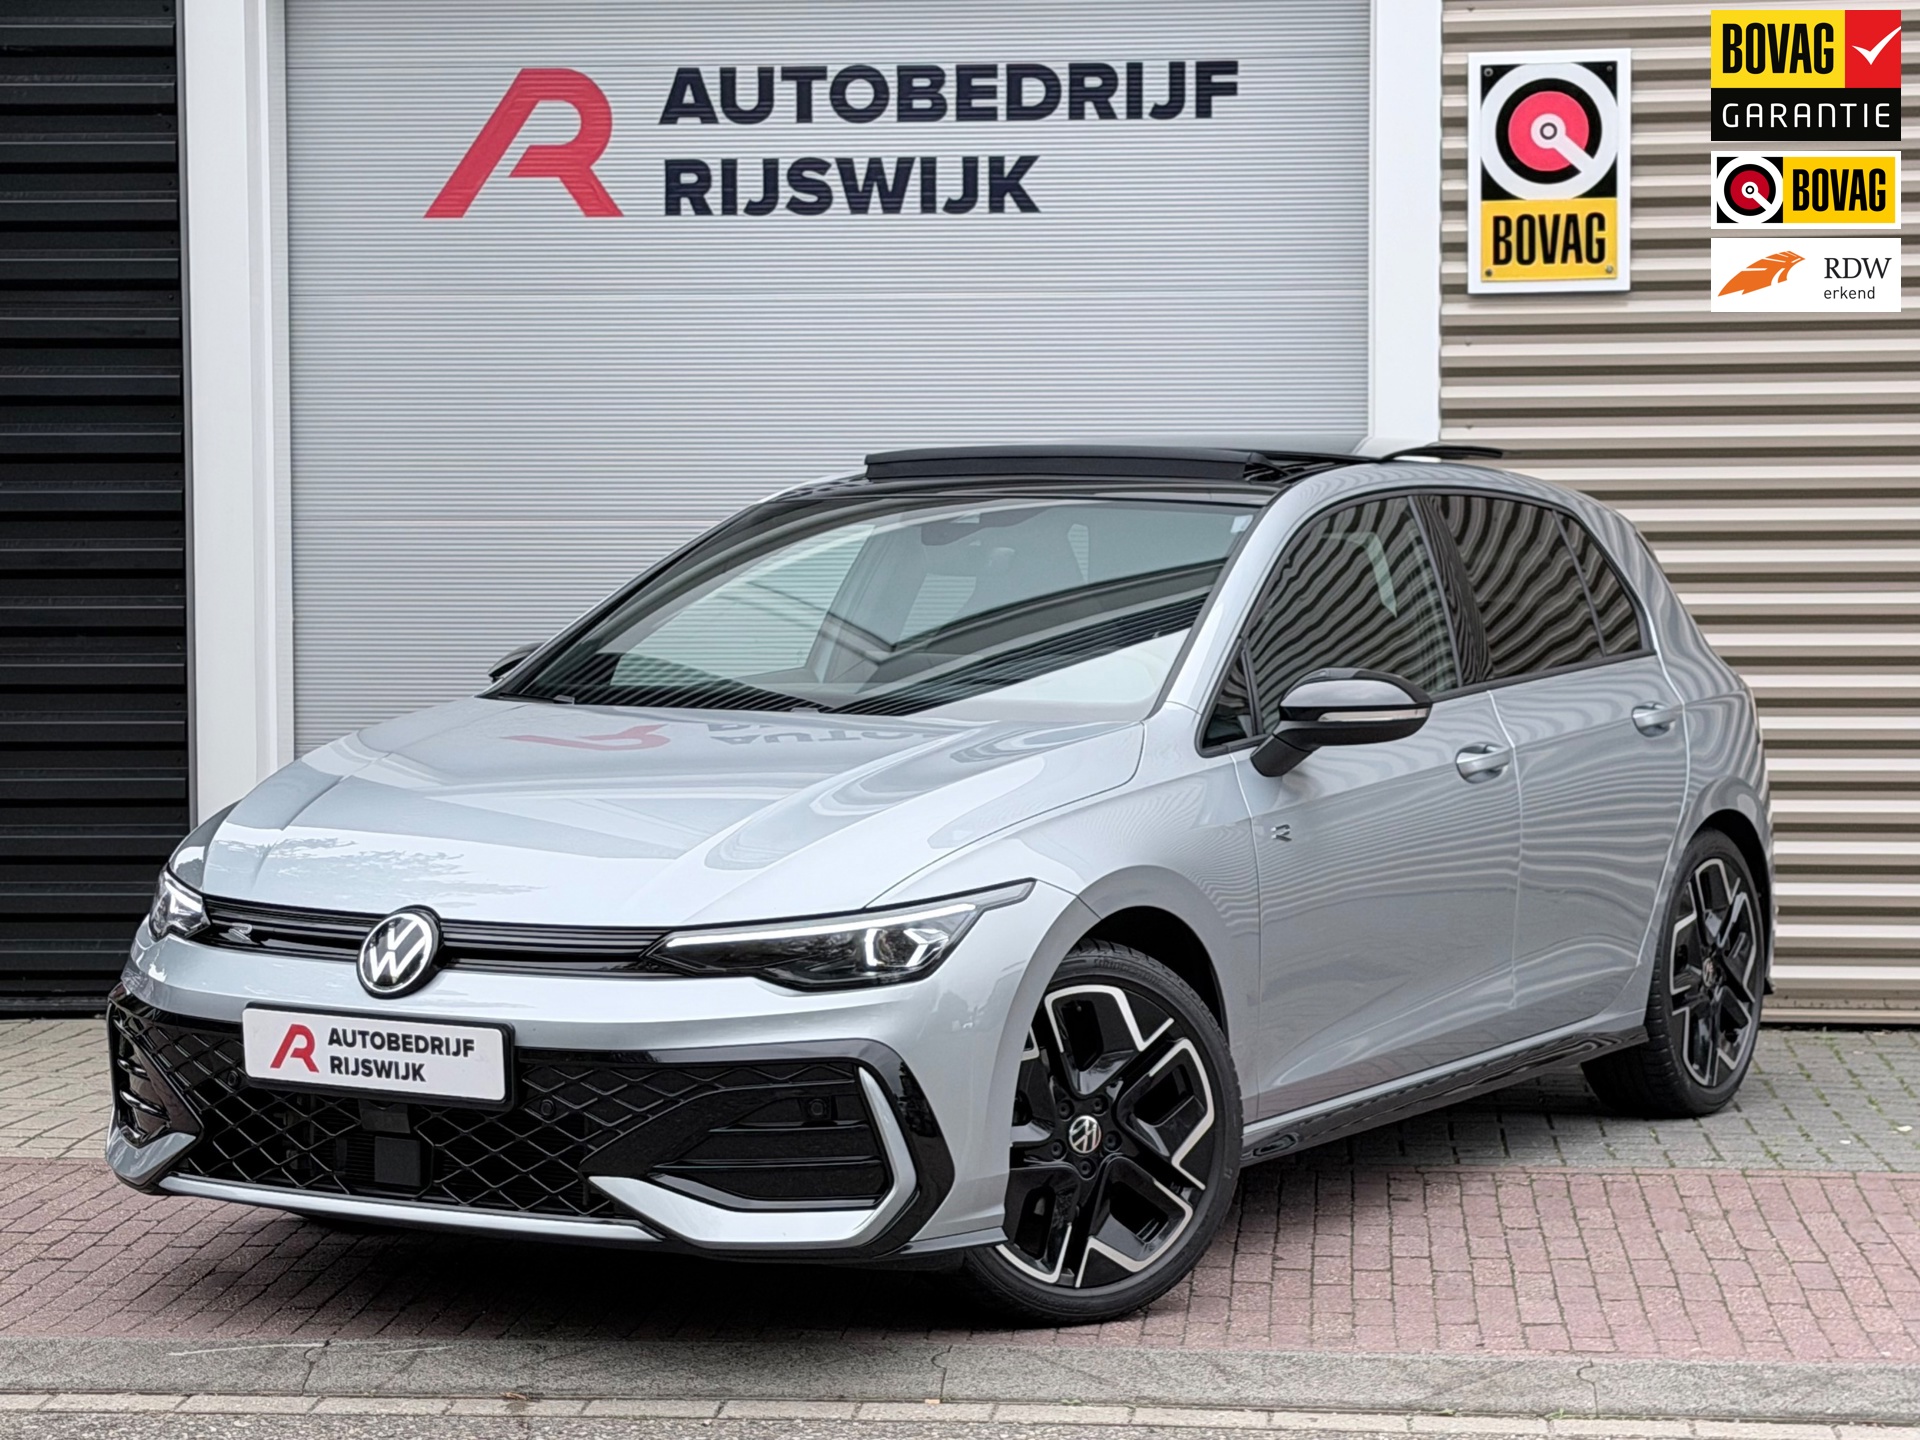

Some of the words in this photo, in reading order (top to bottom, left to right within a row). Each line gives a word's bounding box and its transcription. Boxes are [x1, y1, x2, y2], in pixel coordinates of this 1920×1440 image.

[658, 60, 1240, 125] AUTOBEDRIJF
[664, 155, 1041, 216] RIJSWIJK
[1492, 212, 1606, 266] BOVAG
[327, 1027, 475, 1058] AUTOBEDRIJF
[329, 1055, 426, 1082] RIJSWIJK
